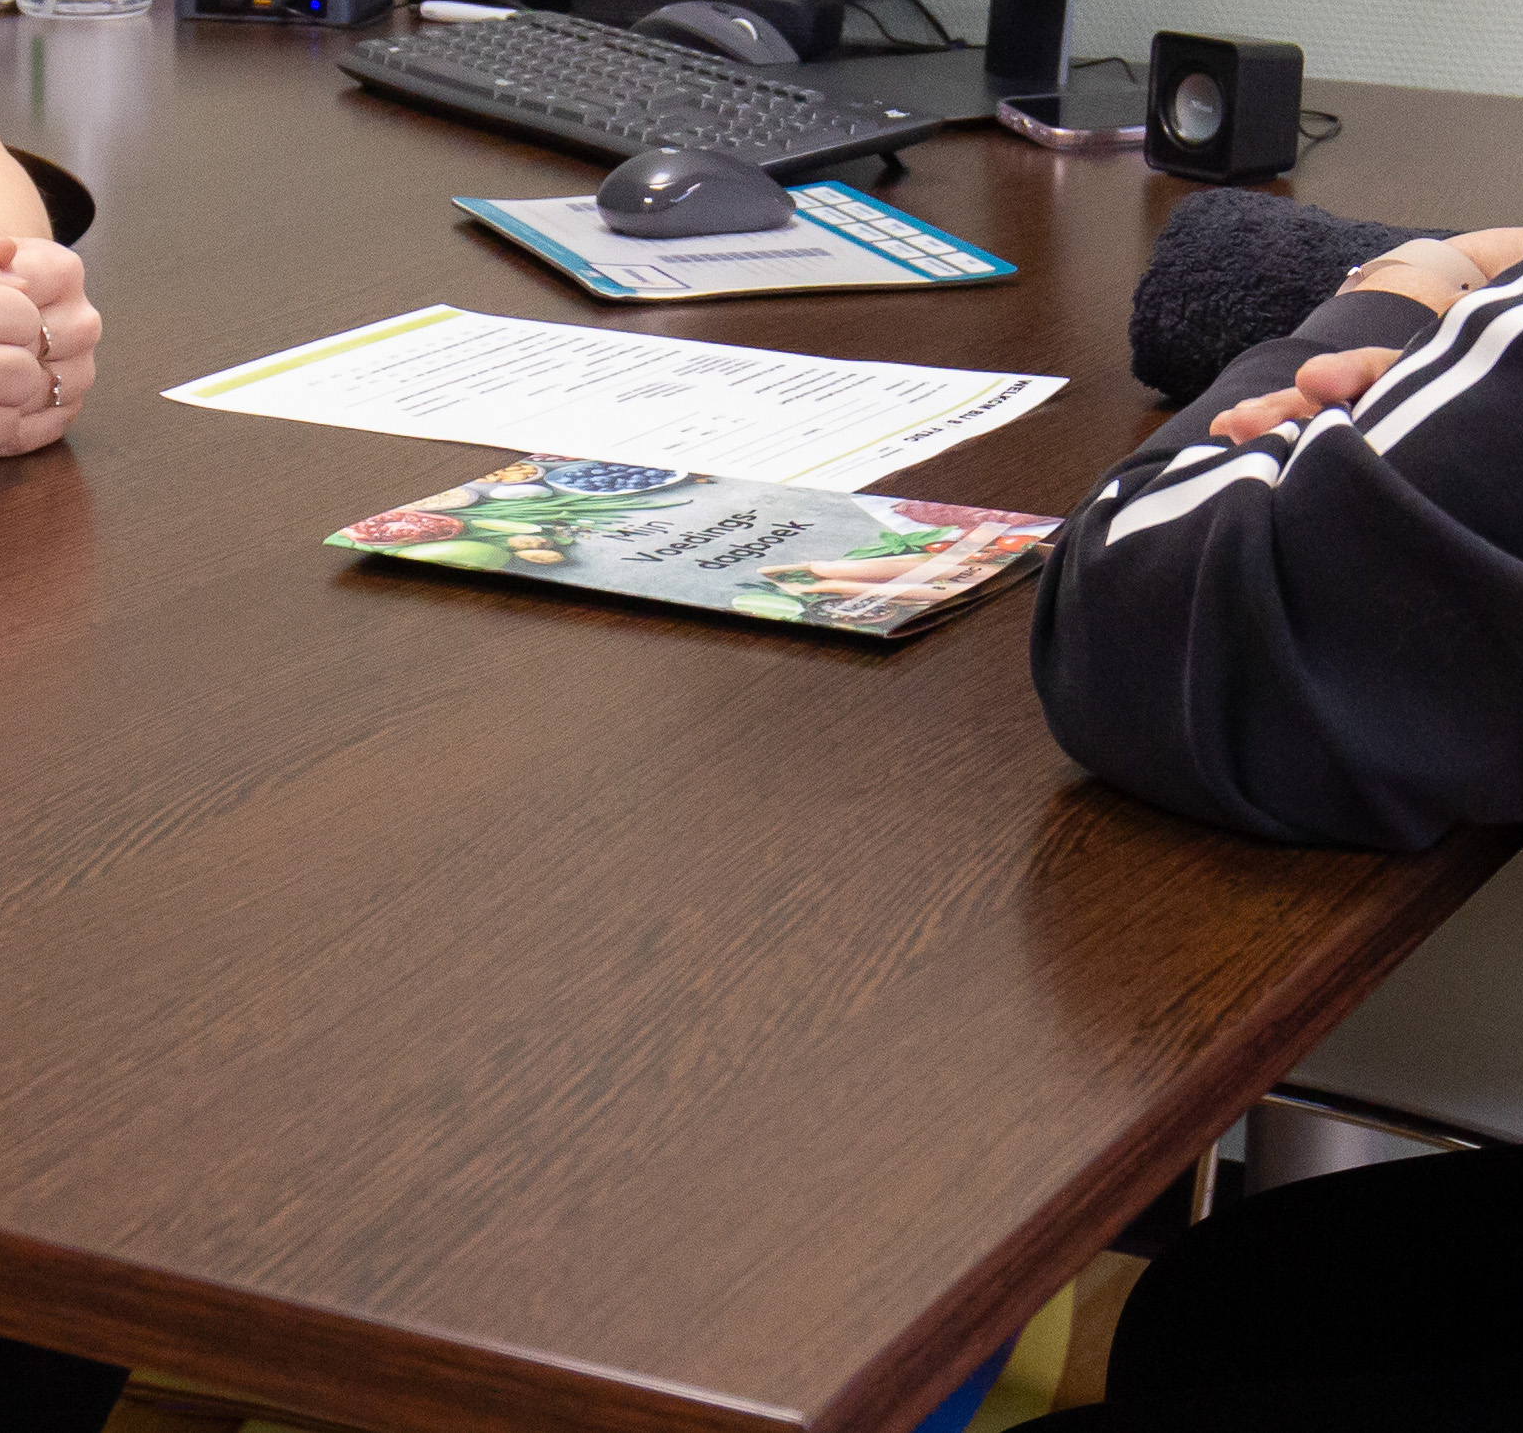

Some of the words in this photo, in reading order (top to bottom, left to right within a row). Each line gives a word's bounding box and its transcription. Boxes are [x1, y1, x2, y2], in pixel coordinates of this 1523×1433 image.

[602, 520, 674, 542] Mijn
[620, 509, 757, 562] Voedings-
[695, 520, 815, 569] dagboek
